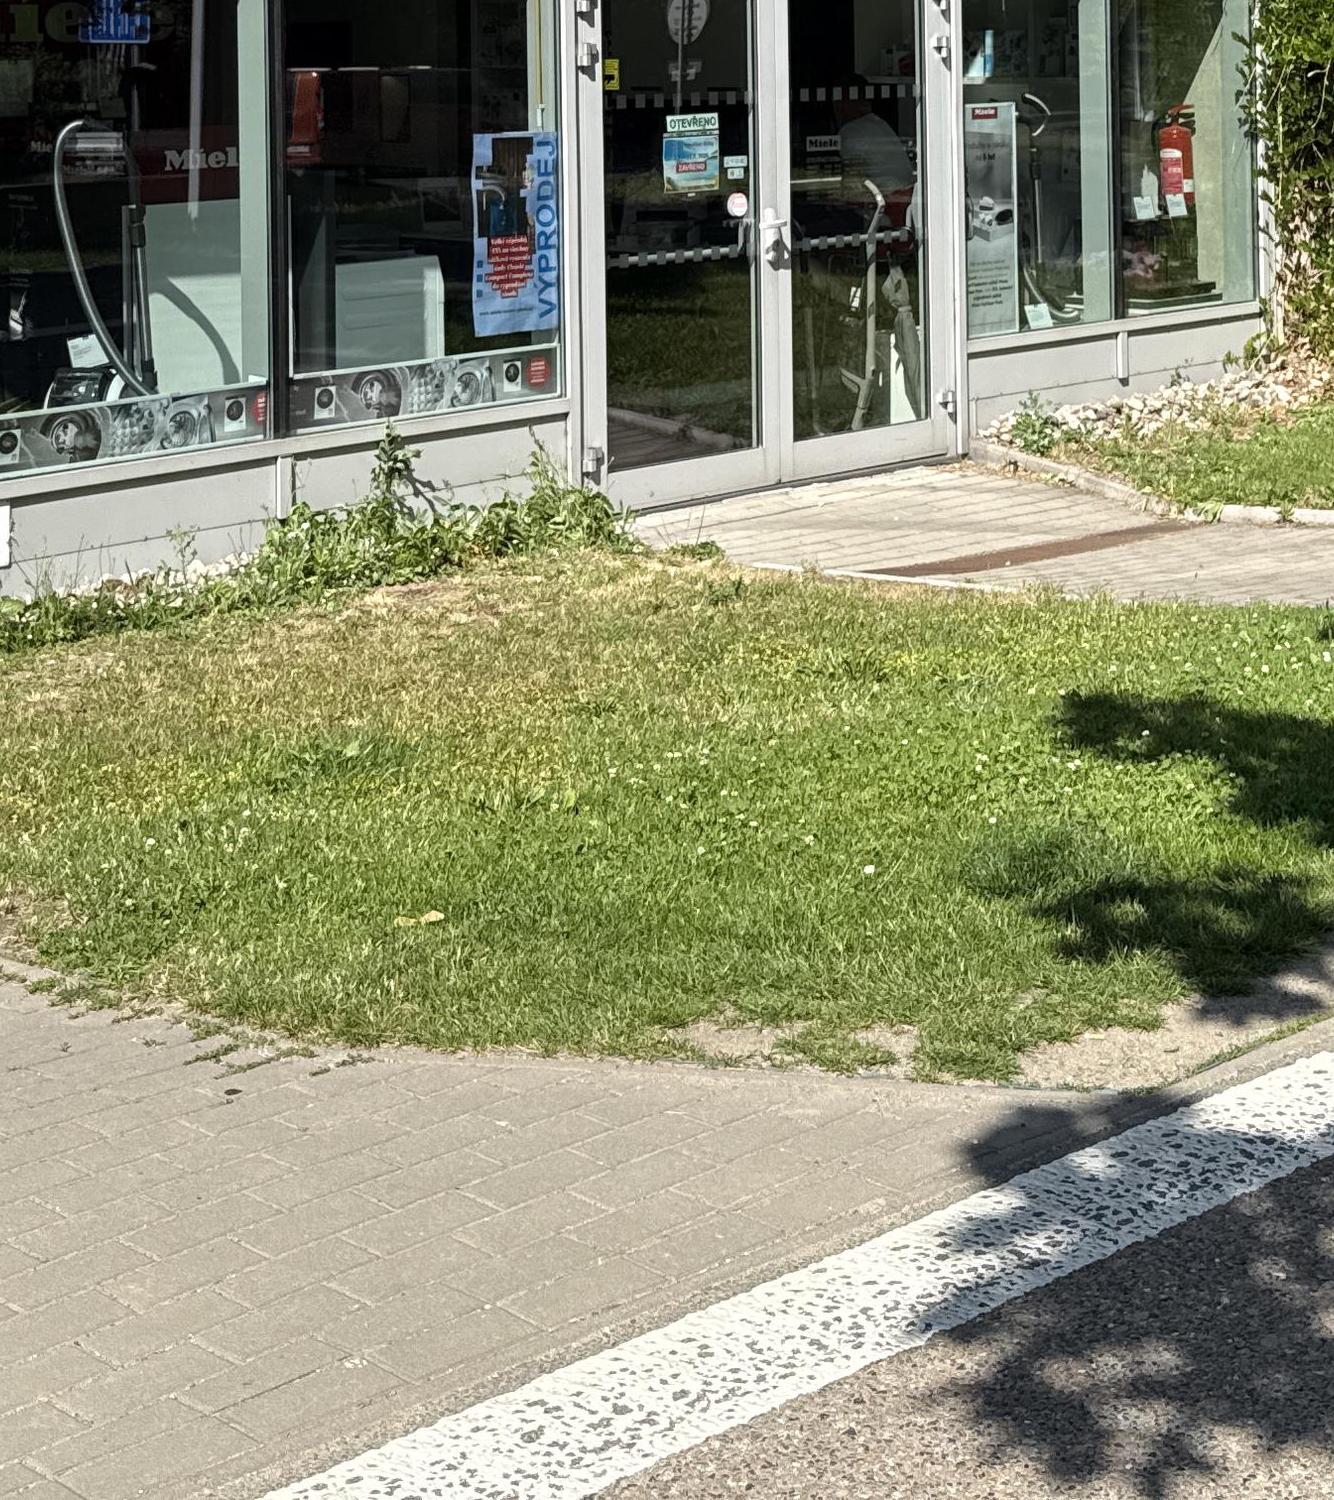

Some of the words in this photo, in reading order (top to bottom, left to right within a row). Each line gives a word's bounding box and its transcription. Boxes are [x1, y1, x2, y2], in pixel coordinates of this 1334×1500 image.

[669, 115, 717, 130] OTEVŘENO
[164, 146, 240, 172] Miel
[534, 140, 557, 319] VÝPRODEJ
